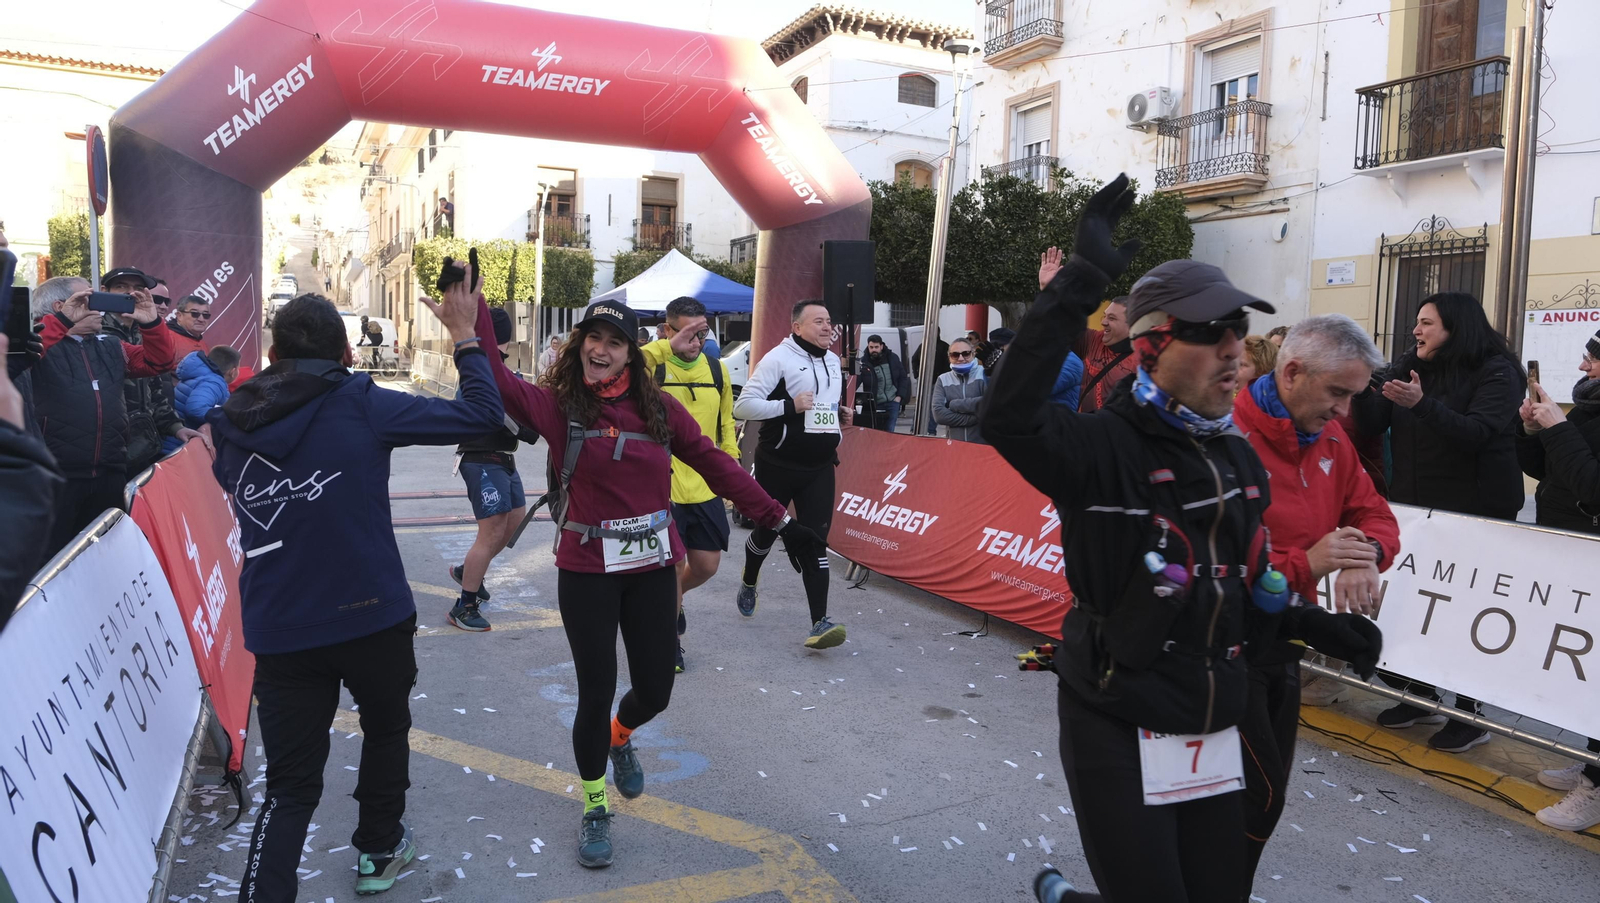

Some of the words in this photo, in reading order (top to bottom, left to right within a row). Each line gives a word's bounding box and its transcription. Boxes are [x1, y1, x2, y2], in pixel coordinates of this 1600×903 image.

[480, 64, 611, 96] TEAMERGY
[203, 55, 315, 155] TEAMERGY
[740, 111, 824, 207] TEAMERGY
[813, 412, 835, 425] 380
[243, 469, 342, 501] ens
[247, 499, 272, 509] EVENTOS
[273, 495, 289, 503] NON
[290, 491, 309, 500] STOP
[612, 519, 621, 527] IV
[836, 491, 940, 536] TEAMERGY
[619, 534, 659, 556] 216
[845, 527, 900, 551] www.teamergy.es
[990, 570, 1066, 603] www.teamergy.es
[1397, 553, 1592, 614] AMIENT
[0, 591, 136, 815] AYUNTAMIENTO
[132, 570, 152, 607] DE
[32, 610, 179, 903] CANTORIA
[1185, 740, 1204, 774] 7
[249, 852, 262, 879] NON
